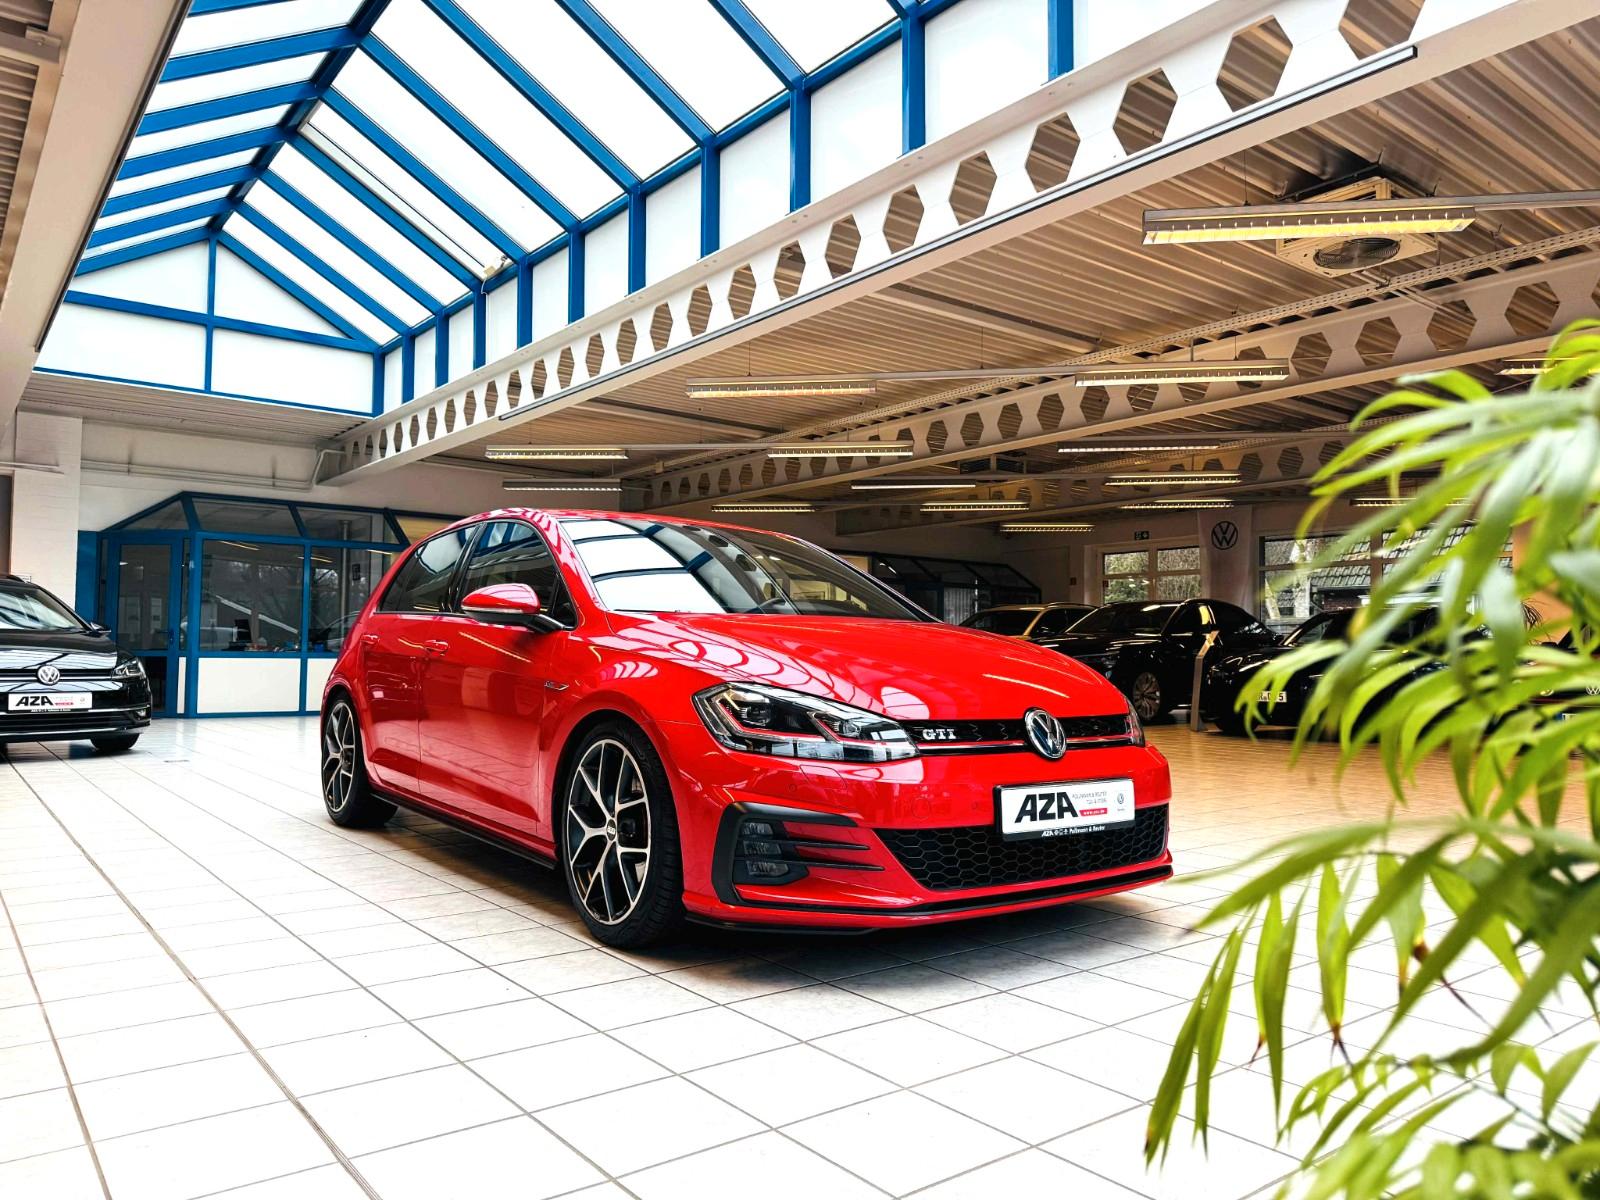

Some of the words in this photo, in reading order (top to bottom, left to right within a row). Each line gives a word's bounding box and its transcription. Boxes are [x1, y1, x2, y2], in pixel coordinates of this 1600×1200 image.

[16, 696, 53, 706] AZA
[922, 728, 957, 740] GTI
[1014, 792, 1079, 823] AZA
